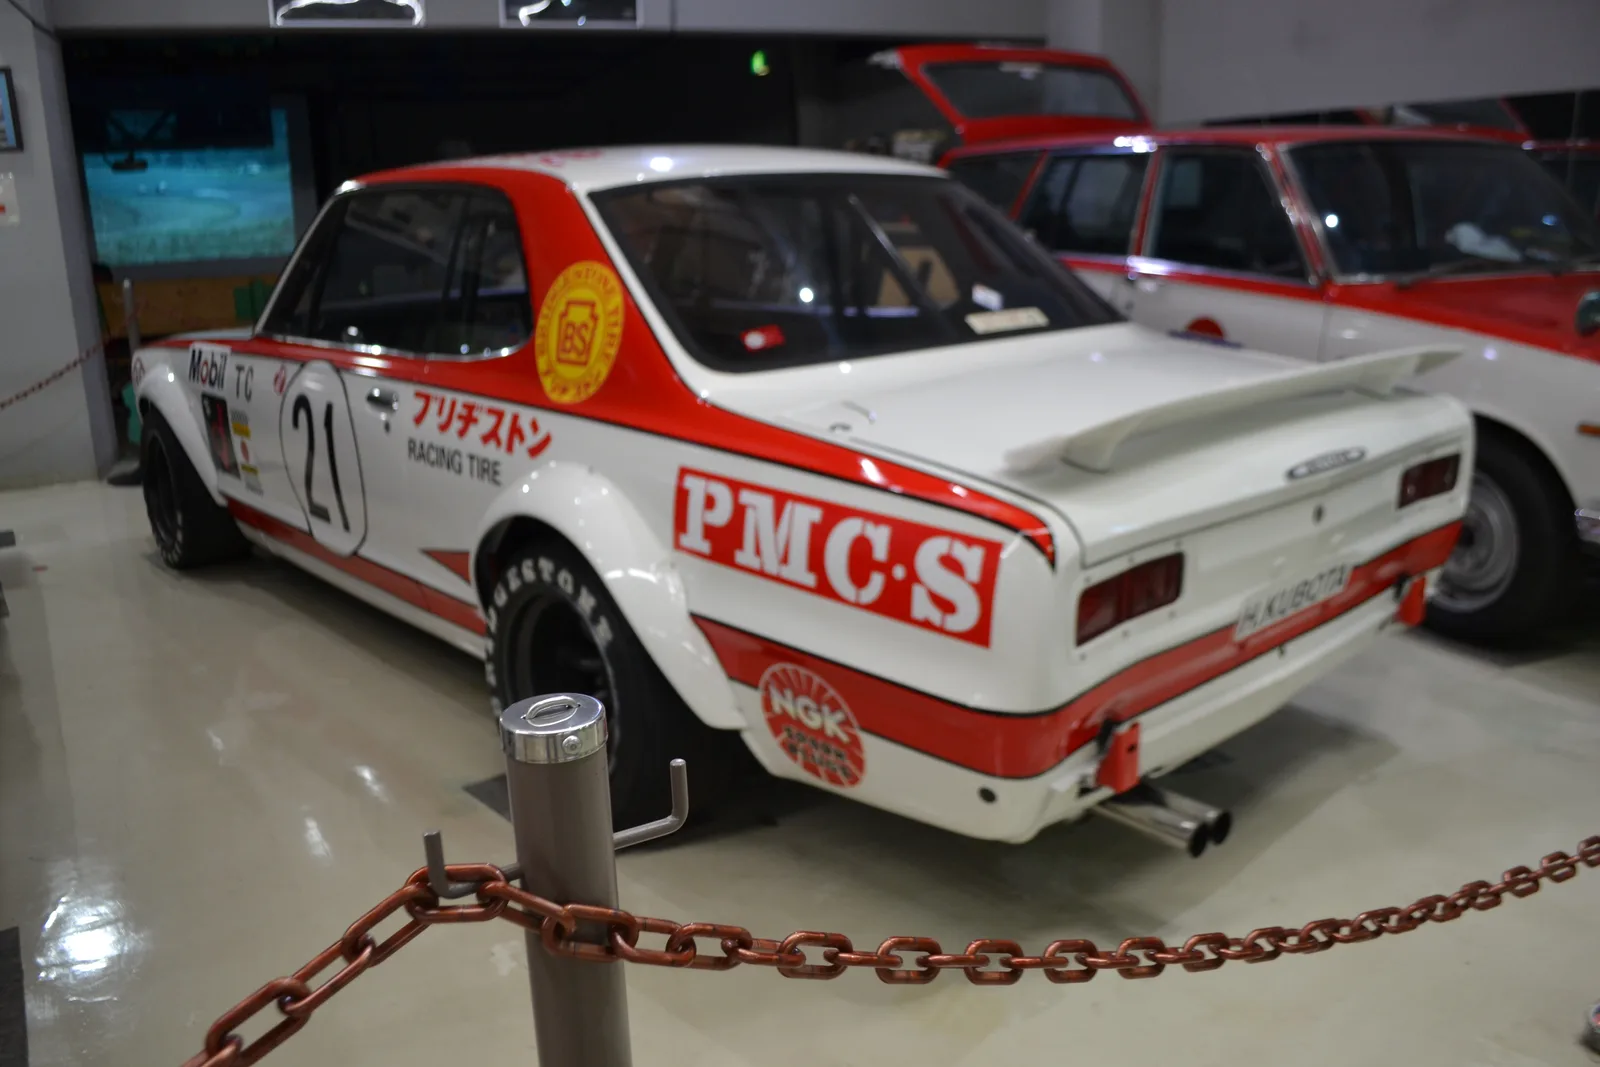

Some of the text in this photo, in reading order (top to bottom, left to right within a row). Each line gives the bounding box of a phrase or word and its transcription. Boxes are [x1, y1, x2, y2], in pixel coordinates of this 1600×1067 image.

[563, 322, 590, 357] BS
[188, 348, 254, 403] Mobil TC
[292, 394, 350, 533] 21
[407, 437, 503, 487] RACING TIRE
[769, 684, 851, 744] NGK
